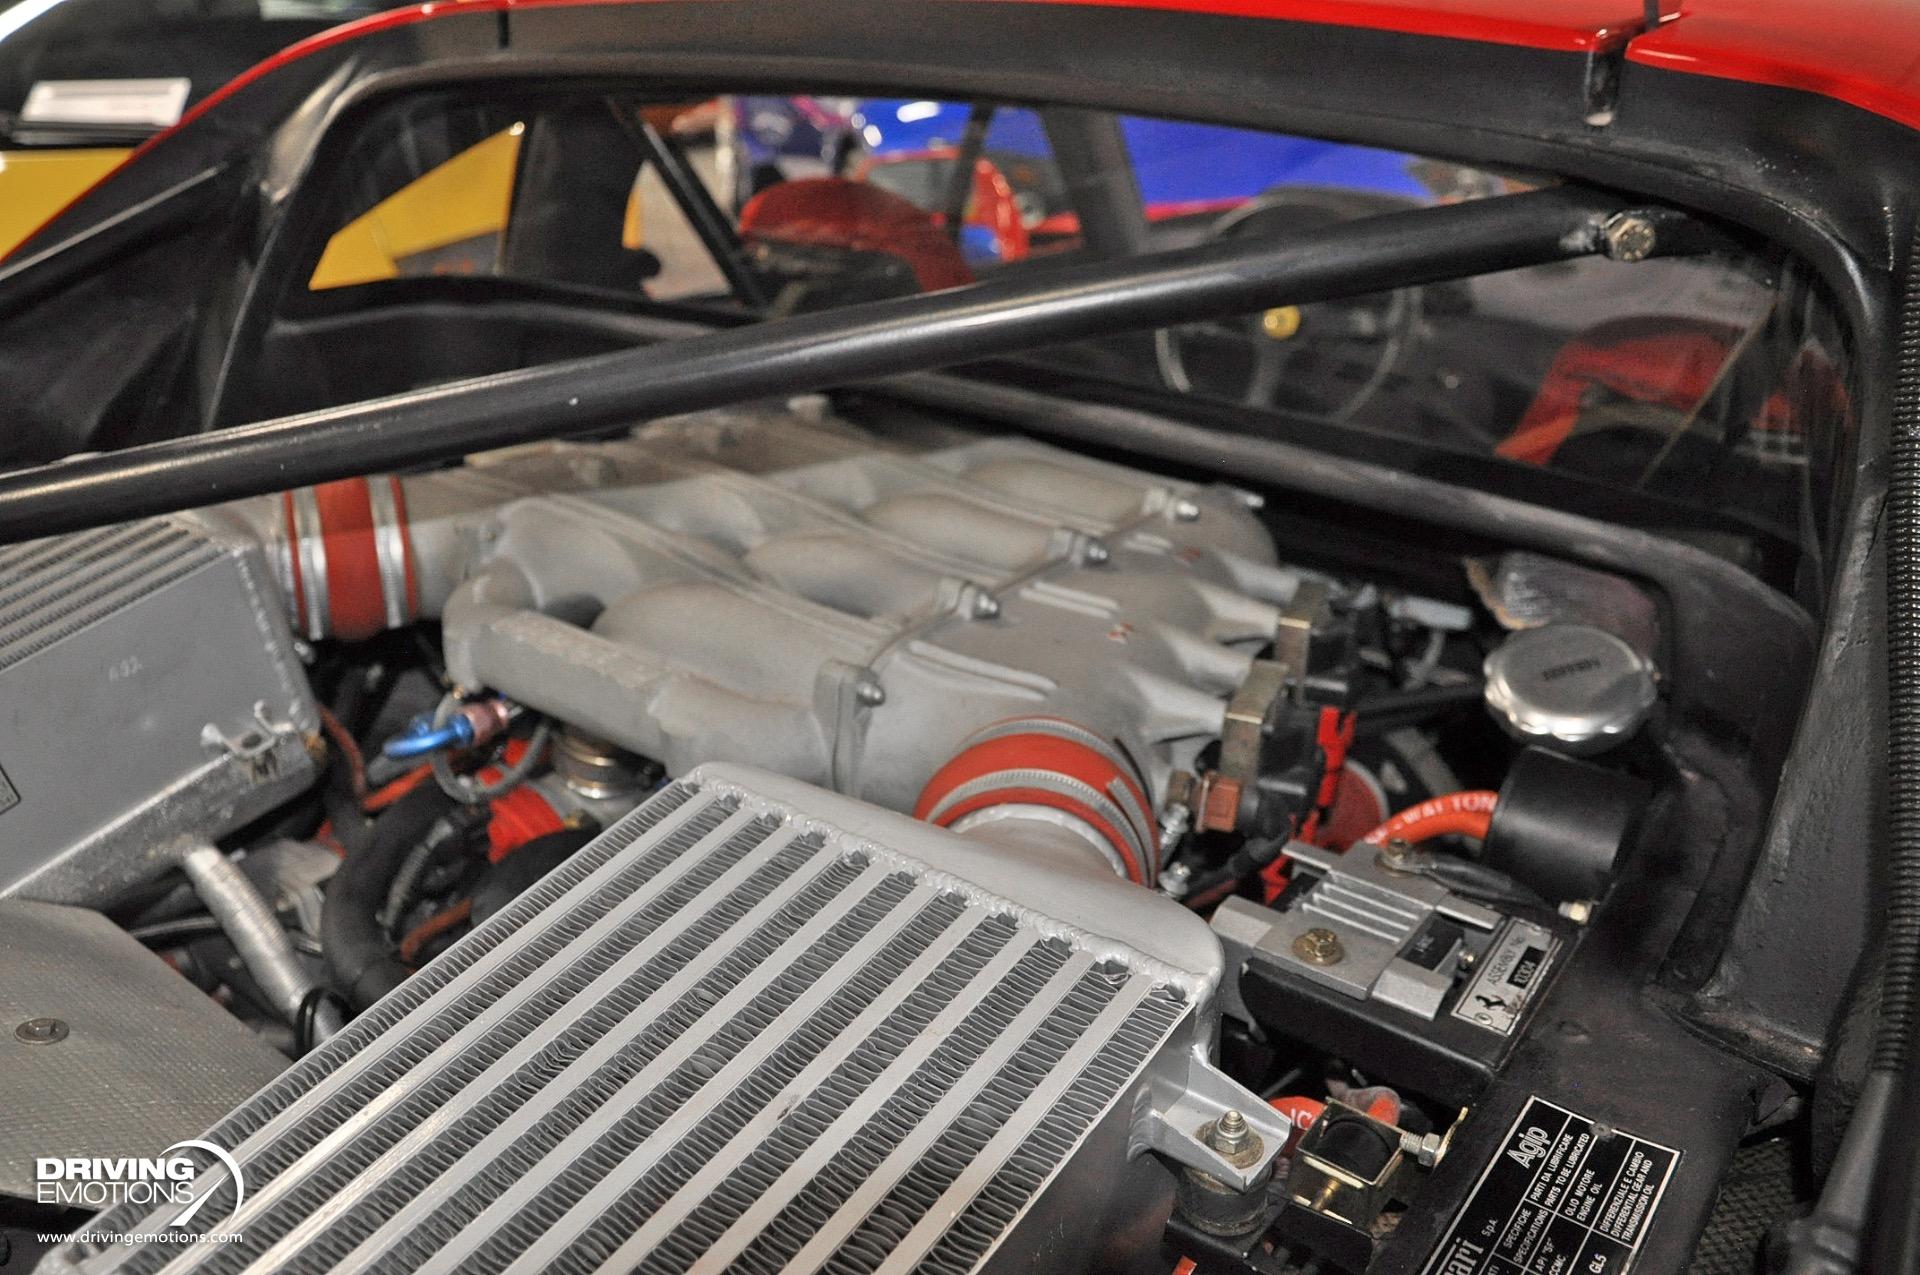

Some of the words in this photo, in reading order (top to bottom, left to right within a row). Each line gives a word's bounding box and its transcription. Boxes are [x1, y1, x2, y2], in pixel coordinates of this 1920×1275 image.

[1507, 1127, 1551, 1169] Agip
[1530, 1182, 1547, 1201] PARTI
[1541, 1172, 1552, 1182] DA
[1547, 1133, 1574, 1172] LUBRIFICARE
[1566, 1133, 1590, 1169] LUBRICATED
[1555, 1175, 1567, 1186] TO
[1560, 1167, 1572, 1178] BE
[1600, 1183, 1630, 1232] DIFFERENZIALE
[1626, 1151, 1645, 1177] CAMBIO
[1544, 1186, 1561, 1207] PARTS
[1564, 1198, 1580, 1217] OLIO
[1574, 1169, 1596, 1197] MOTORE
[1576, 1195, 1596, 1221] ENGINE
[1590, 1183, 1603, 1195] OIL
[1610, 1192, 1639, 1237] DIFFERENTIAL
[1631, 1173, 1647, 1192] GEAR
[1640, 1159, 1653, 1175] AND
[1621, 1193, 1649, 1241] TRANSMISSION
[1642, 1184, 1655, 1195] OIL
[1503, 1208, 1532, 1249] SPECIFICHE
[1513, 1208, 1549, 1263] SPECIFICATIONS
[1443, 1237, 1484, 1275] ari
[1535, 1256, 1549, 1272] API
[1588, 1253, 1607, 1274] GL5
